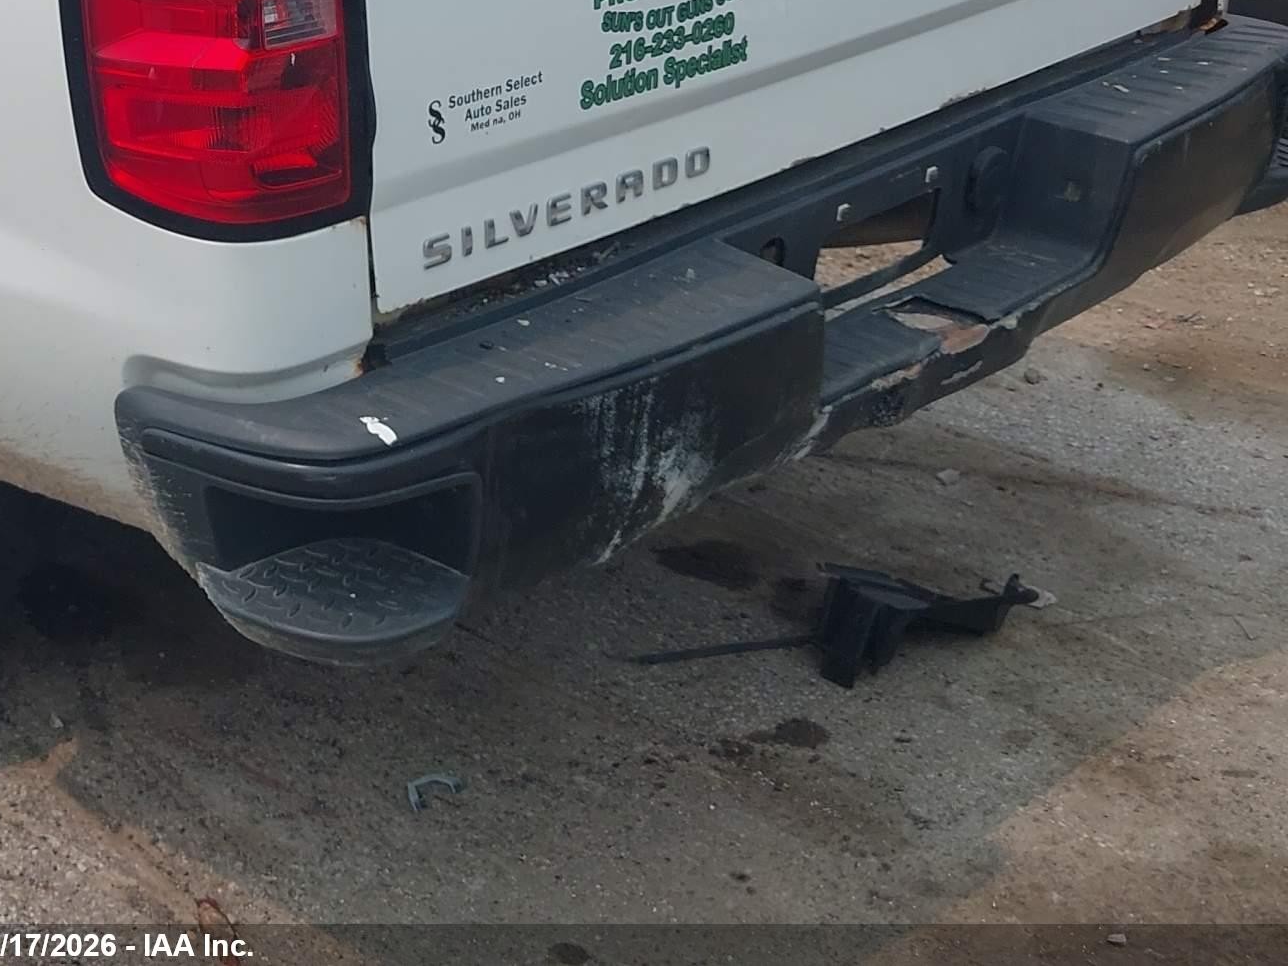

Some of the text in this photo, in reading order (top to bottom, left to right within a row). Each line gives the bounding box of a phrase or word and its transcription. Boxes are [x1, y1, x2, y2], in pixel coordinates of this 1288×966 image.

[646, 5, 674, 30] OUT
[609, 11, 736, 70] 216-233-0260
[448, 71, 543, 109] Southern Select
[579, 35, 749, 110] Solution Specialist
[464, 95, 528, 122] Auto Sales
[508, 109, 522, 122] OH
[422, 145, 711, 270] SILVERADO
